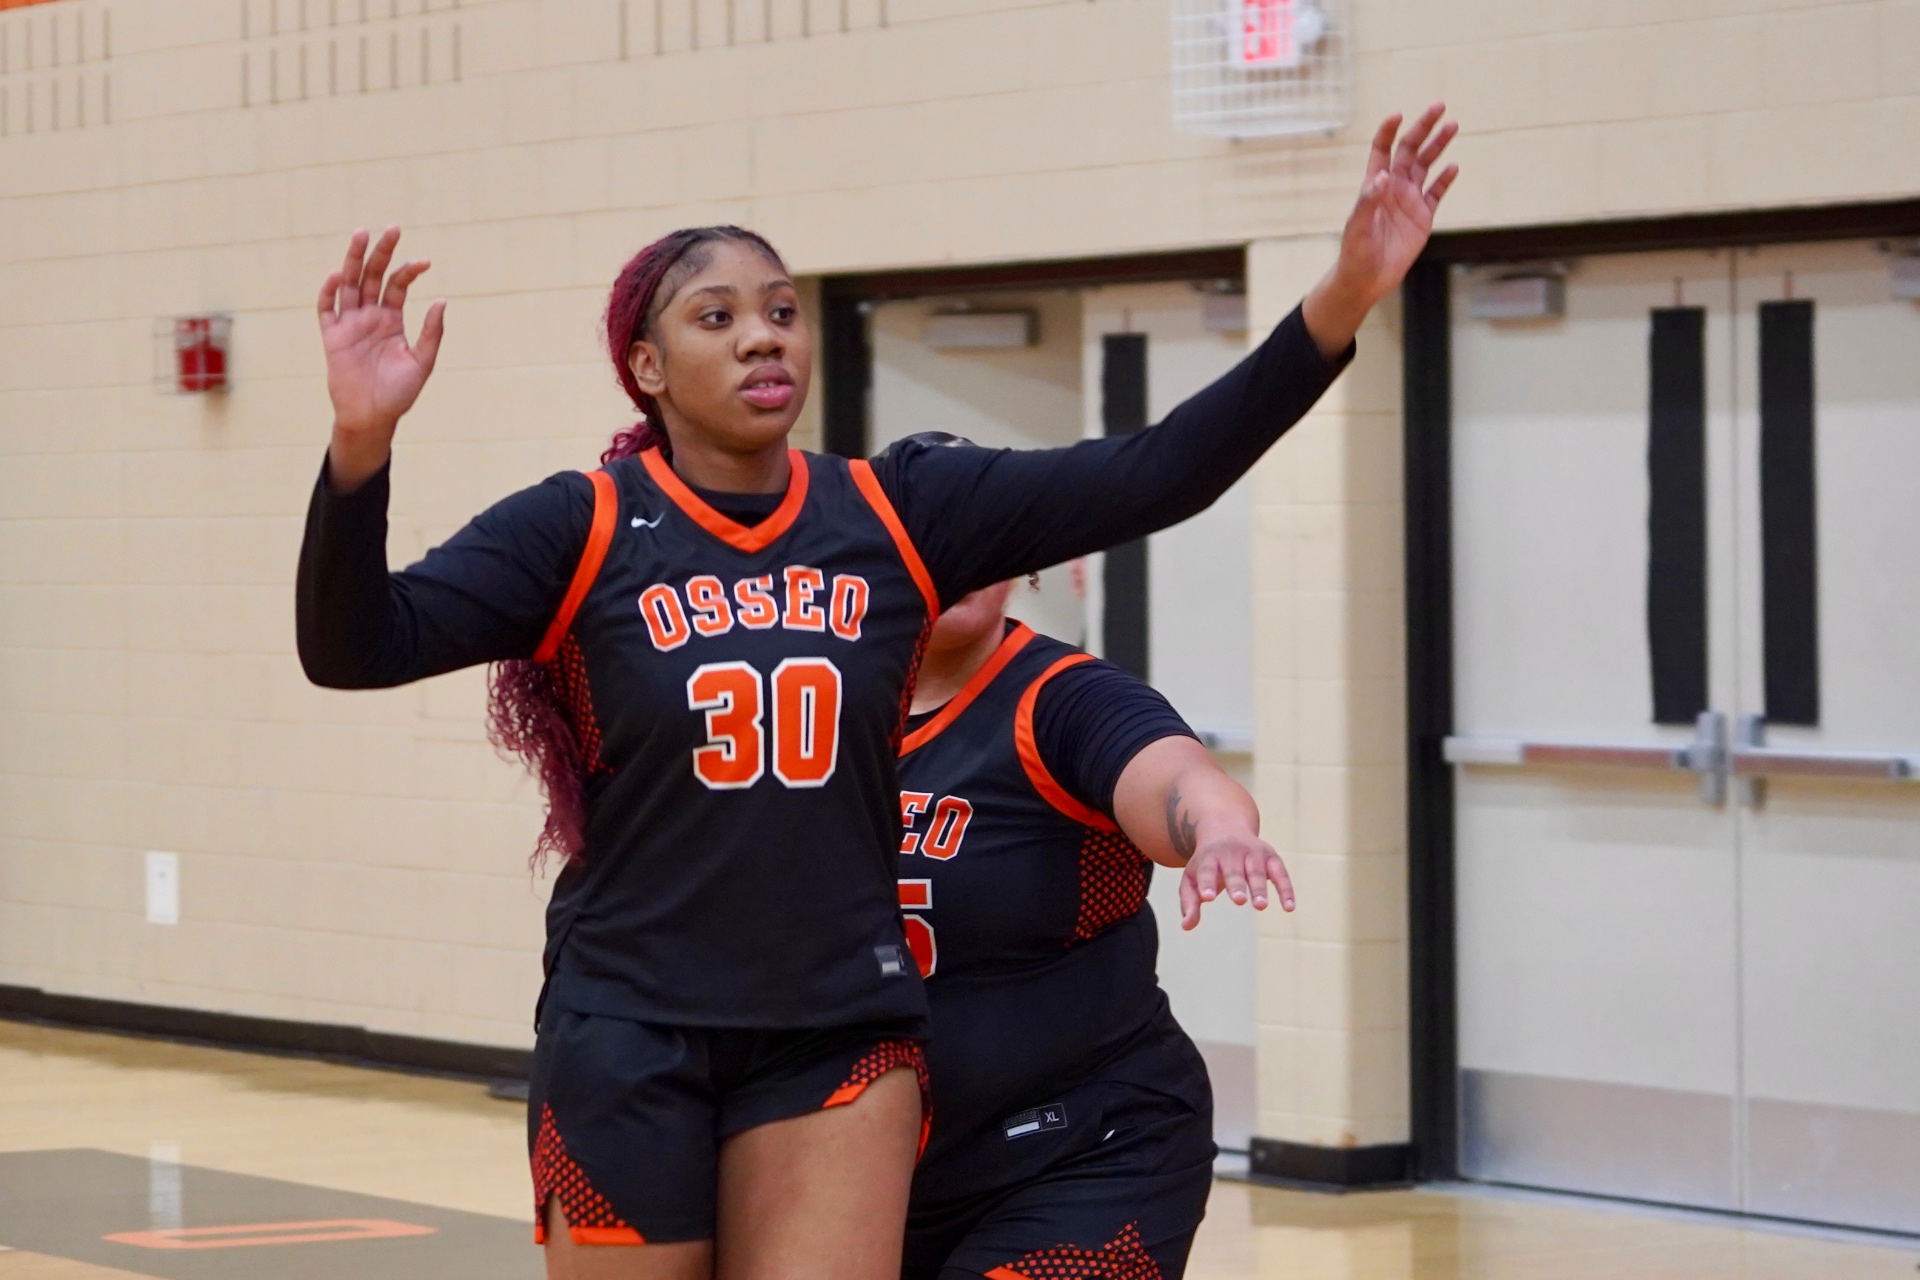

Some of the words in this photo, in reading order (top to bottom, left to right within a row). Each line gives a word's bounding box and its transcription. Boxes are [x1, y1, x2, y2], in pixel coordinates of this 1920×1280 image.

[638, 565, 870, 652] OSSEO
[686, 657, 842, 790] 30
[1044, 1111, 1060, 1124] XL
